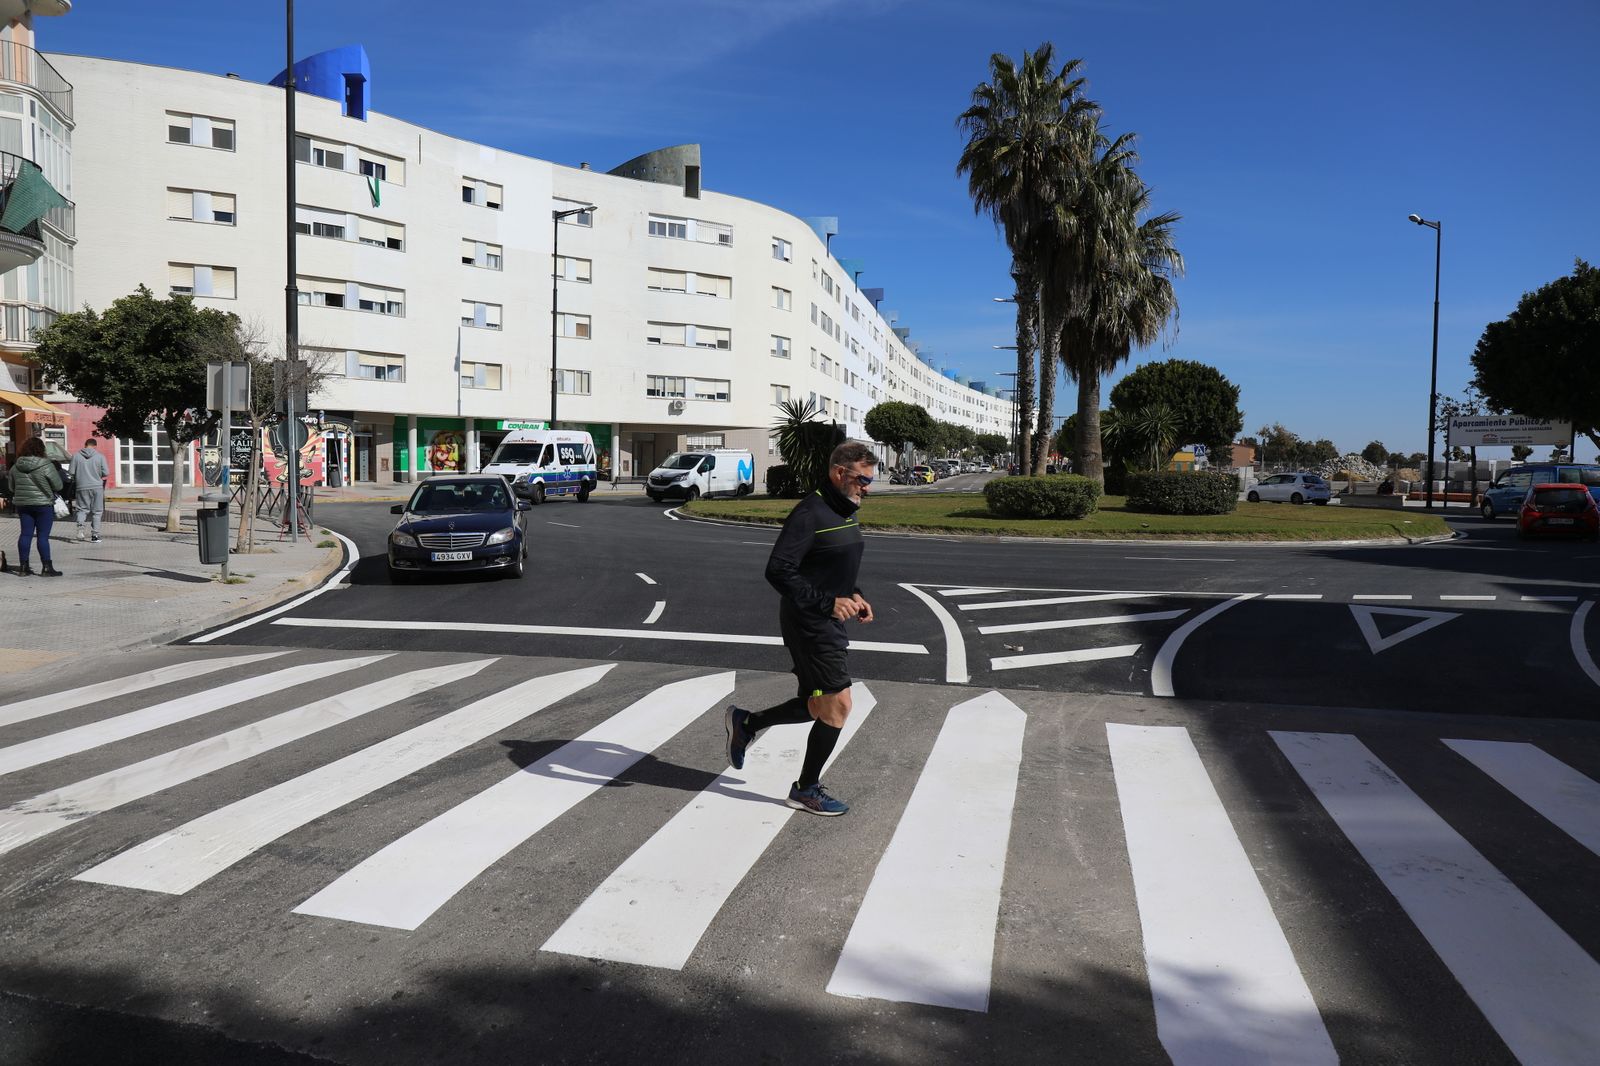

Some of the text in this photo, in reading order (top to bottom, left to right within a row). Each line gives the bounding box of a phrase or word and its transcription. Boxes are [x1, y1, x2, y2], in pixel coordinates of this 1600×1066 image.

[1452, 418, 1507, 429] Aparcamiento
[1509, 417, 1540, 426] Público
[436, 552, 471, 561] 4934 GXV
